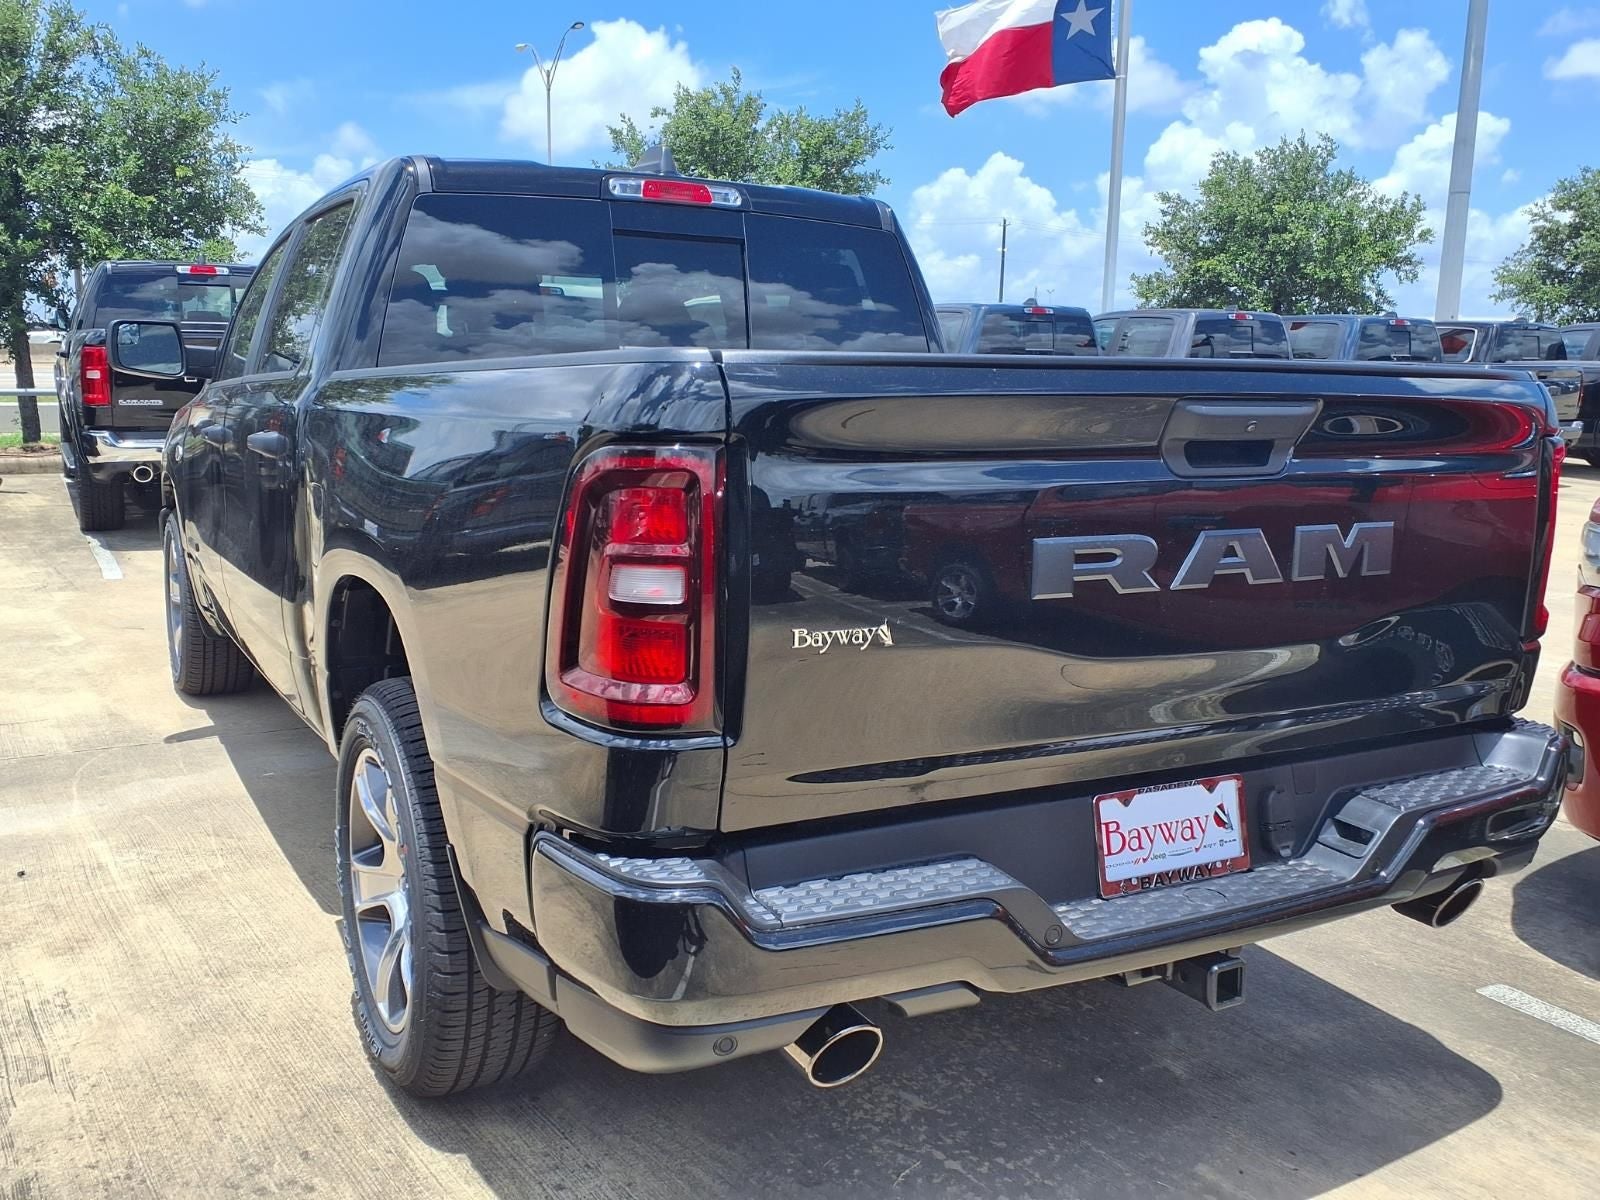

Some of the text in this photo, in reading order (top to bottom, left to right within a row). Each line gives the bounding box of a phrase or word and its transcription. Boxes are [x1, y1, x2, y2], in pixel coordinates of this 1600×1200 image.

[1031, 521, 1395, 600] RAM
[791, 626, 878, 654] Bayway
[1137, 780, 1201, 795] PASADENA
[1101, 814, 1209, 863] Bayway
[1141, 862, 1213, 889] BAYWAY
